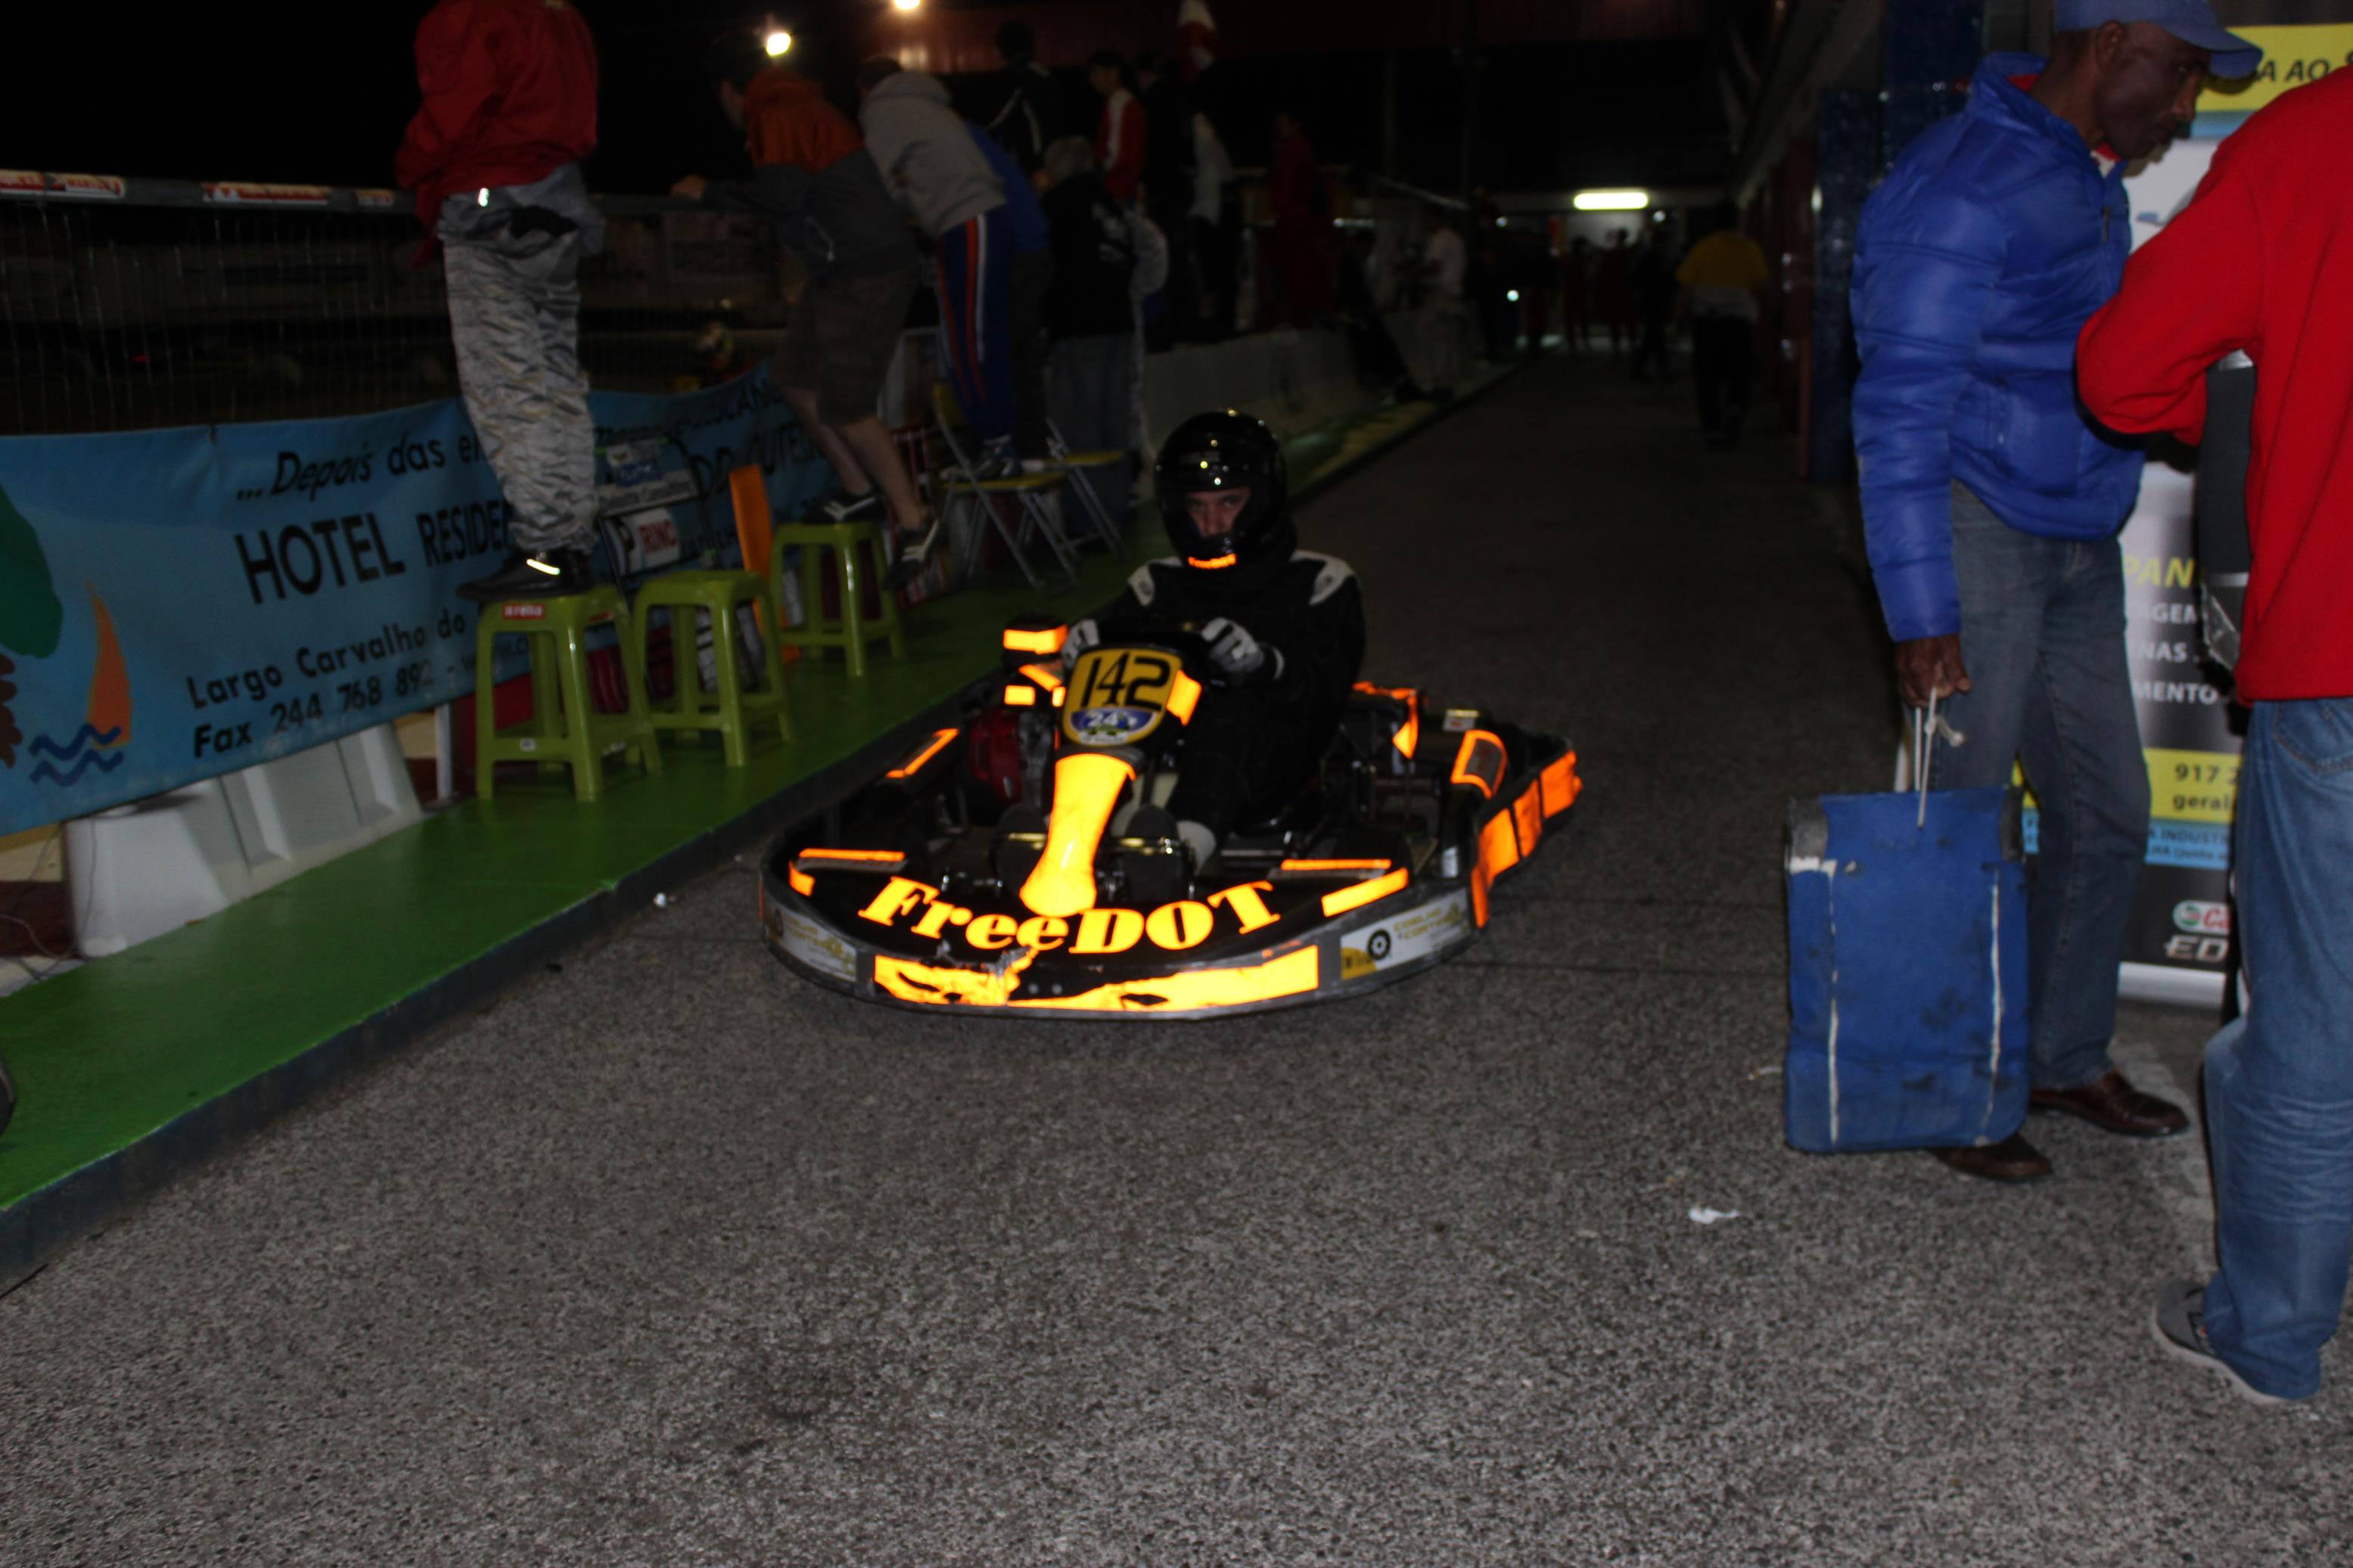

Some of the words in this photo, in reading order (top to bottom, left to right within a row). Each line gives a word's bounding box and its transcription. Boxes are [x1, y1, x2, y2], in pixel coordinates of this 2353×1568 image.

[387, 435, 445, 476] das
[234, 512, 405, 604] HOTEL
[187, 666, 282, 709] Largo
[296, 621, 427, 678] Carvalho
[437, 609, 465, 639] do
[1080, 651, 1171, 712] 142
[194, 721, 251, 758] Fax
[269, 693, 323, 734] 244
[337, 675, 383, 713] 768
[2175, 763, 2220, 783] 917
[857, 875, 1281, 955] FreeDOT
